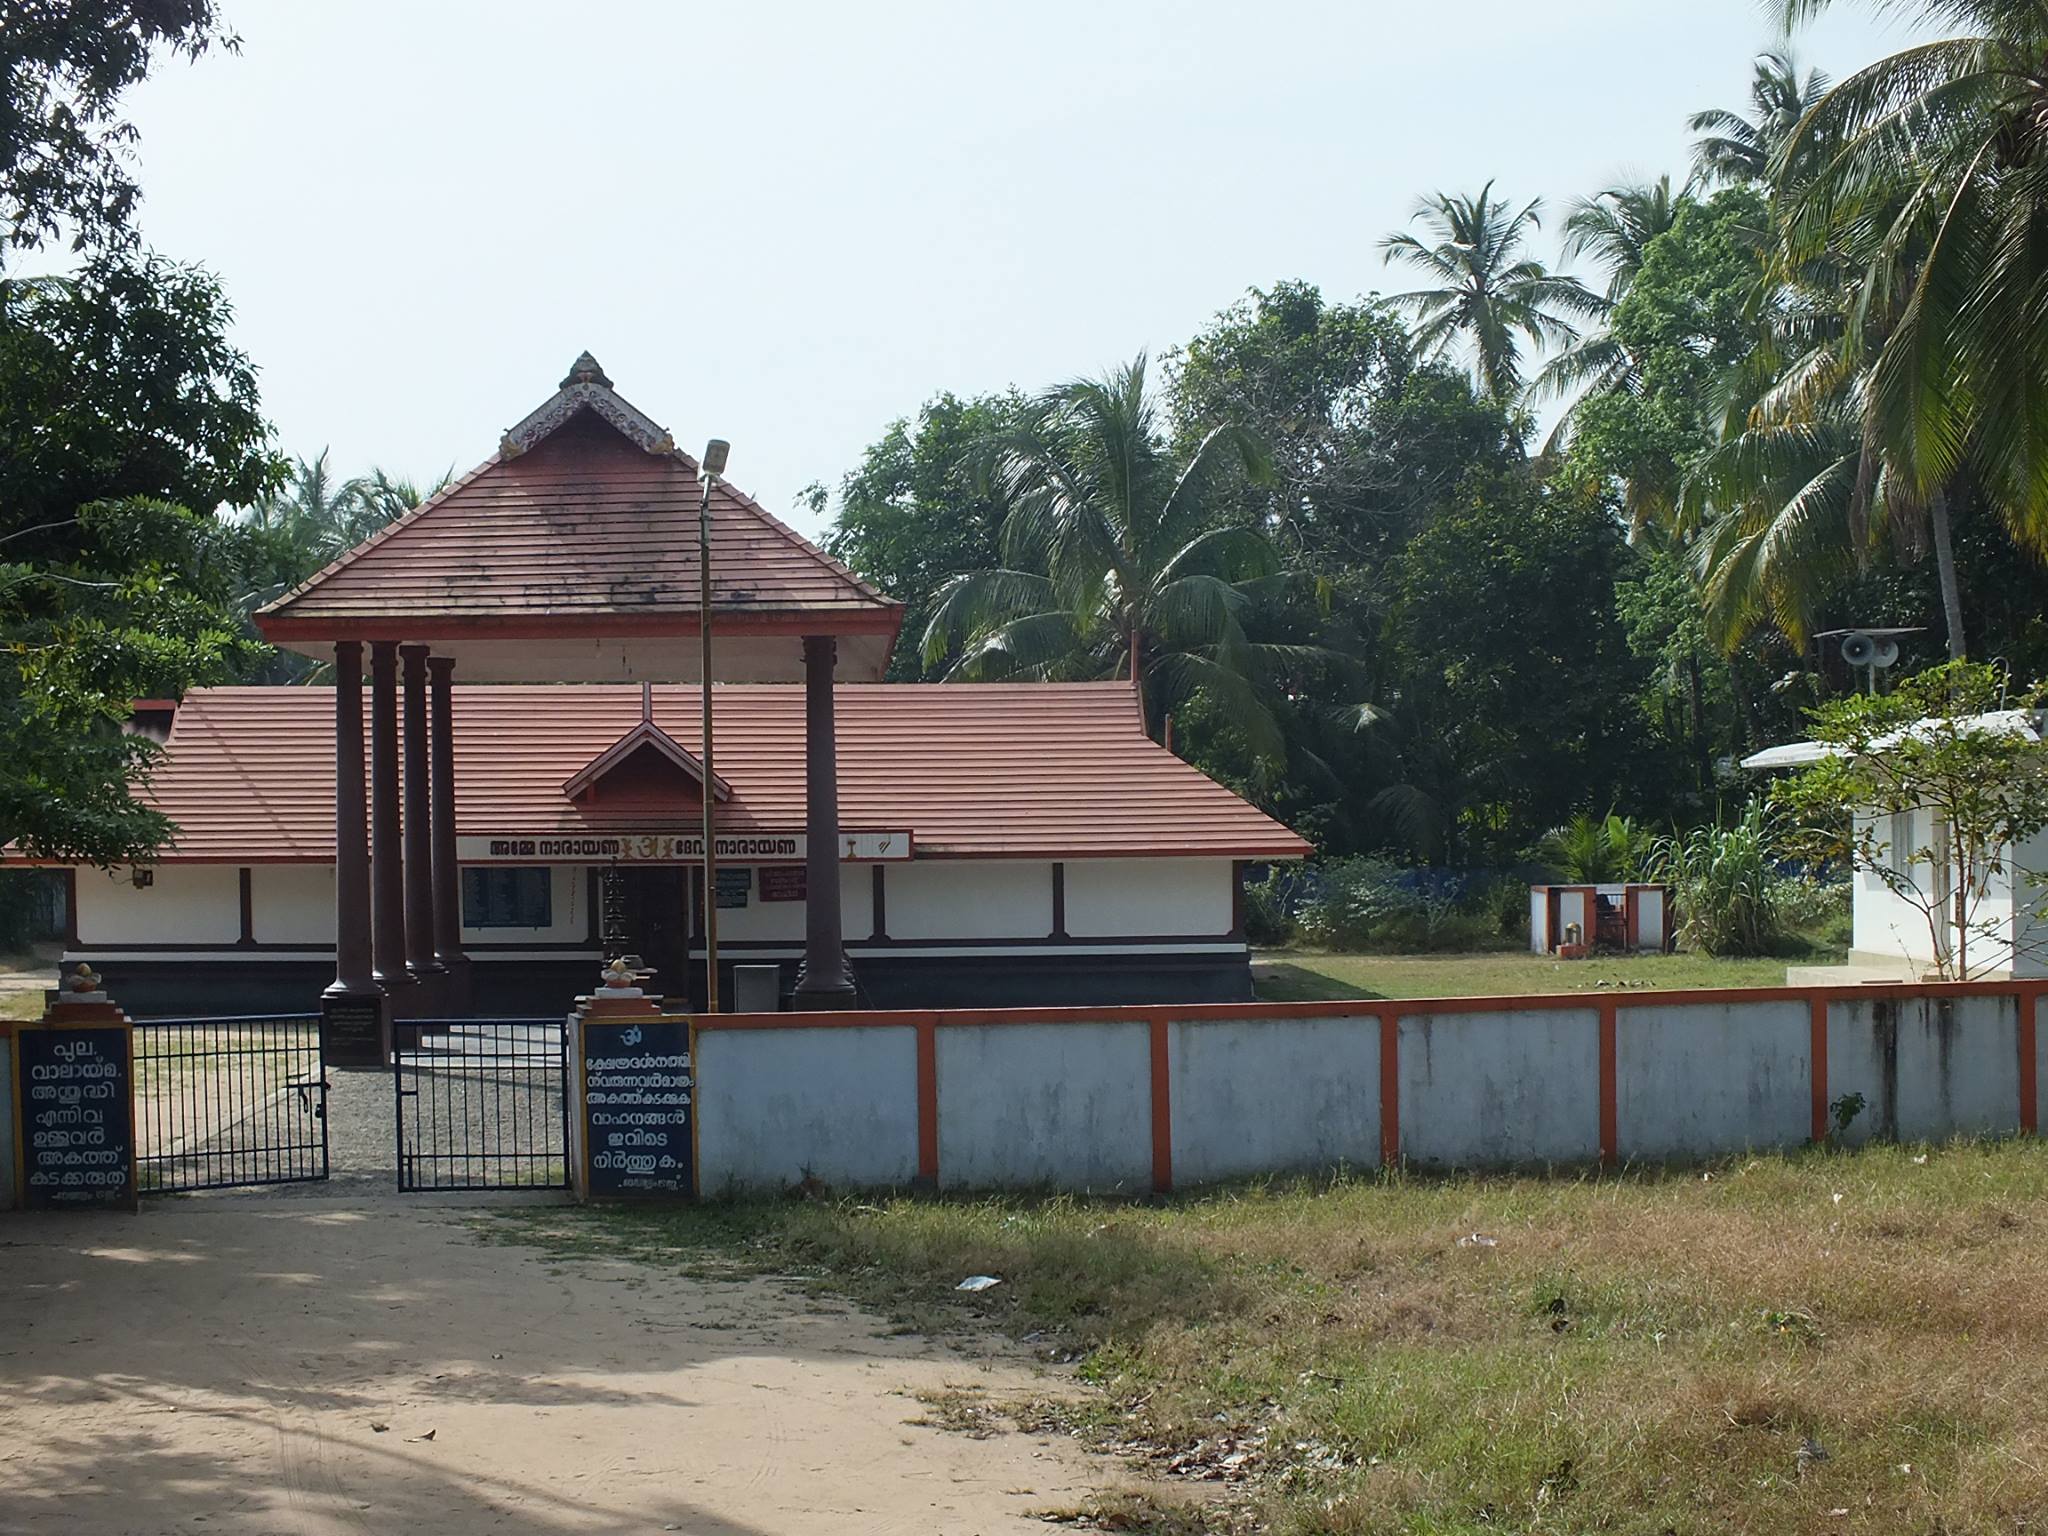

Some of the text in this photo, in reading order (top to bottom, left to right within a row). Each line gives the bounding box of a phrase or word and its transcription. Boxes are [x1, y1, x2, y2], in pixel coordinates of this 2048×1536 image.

[490, 840, 535, 856] അമ്മേ
[539, 839, 619, 856] നാരായണ
[715, 839, 796, 855] നാരായണ
[35, 1105, 104, 1127] എന്നിവ
[592, 1109, 685, 1125] വാഹനങ്ങൾ
[608, 1128, 668, 1146] ഇവിടെ
[37, 1145, 123, 1165] അകത്ത്
[30, 1165, 128, 1186] കടക്കരുത്
